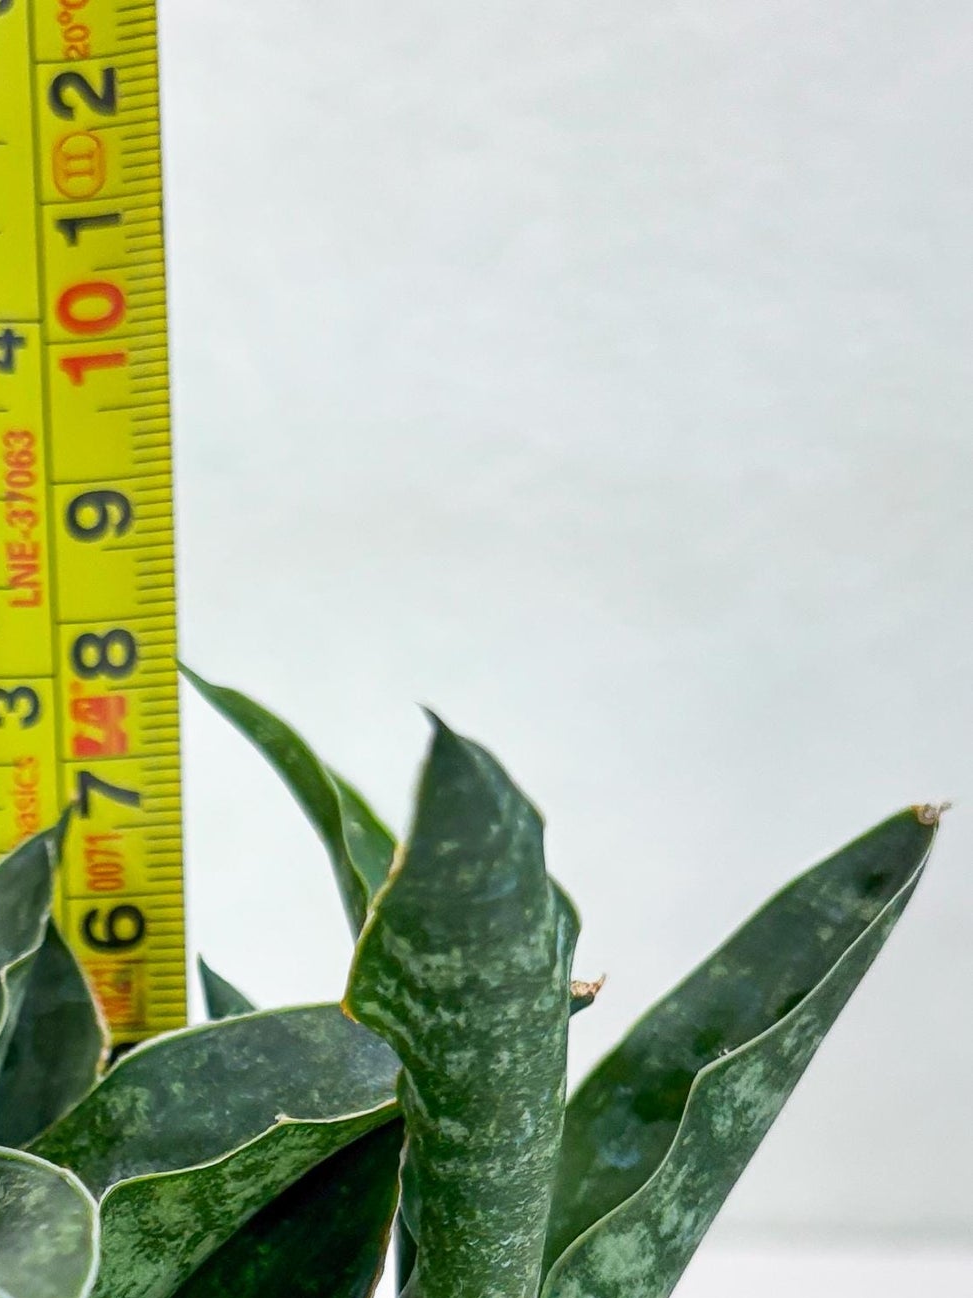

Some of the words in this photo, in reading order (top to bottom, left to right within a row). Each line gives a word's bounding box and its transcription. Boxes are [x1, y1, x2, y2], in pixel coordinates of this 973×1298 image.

[48, 66, 118, 121] 2
[55, 212, 122, 247] 1
[56, 281, 127, 387] 10
[2, 430, 43, 608] LNE-37063
[65, 490, 133, 543] 9
[70, 628, 137, 680] 8
[77, 770, 141, 819] 7
[83, 833, 125, 891] 0071
[82, 904, 146, 953] 6
